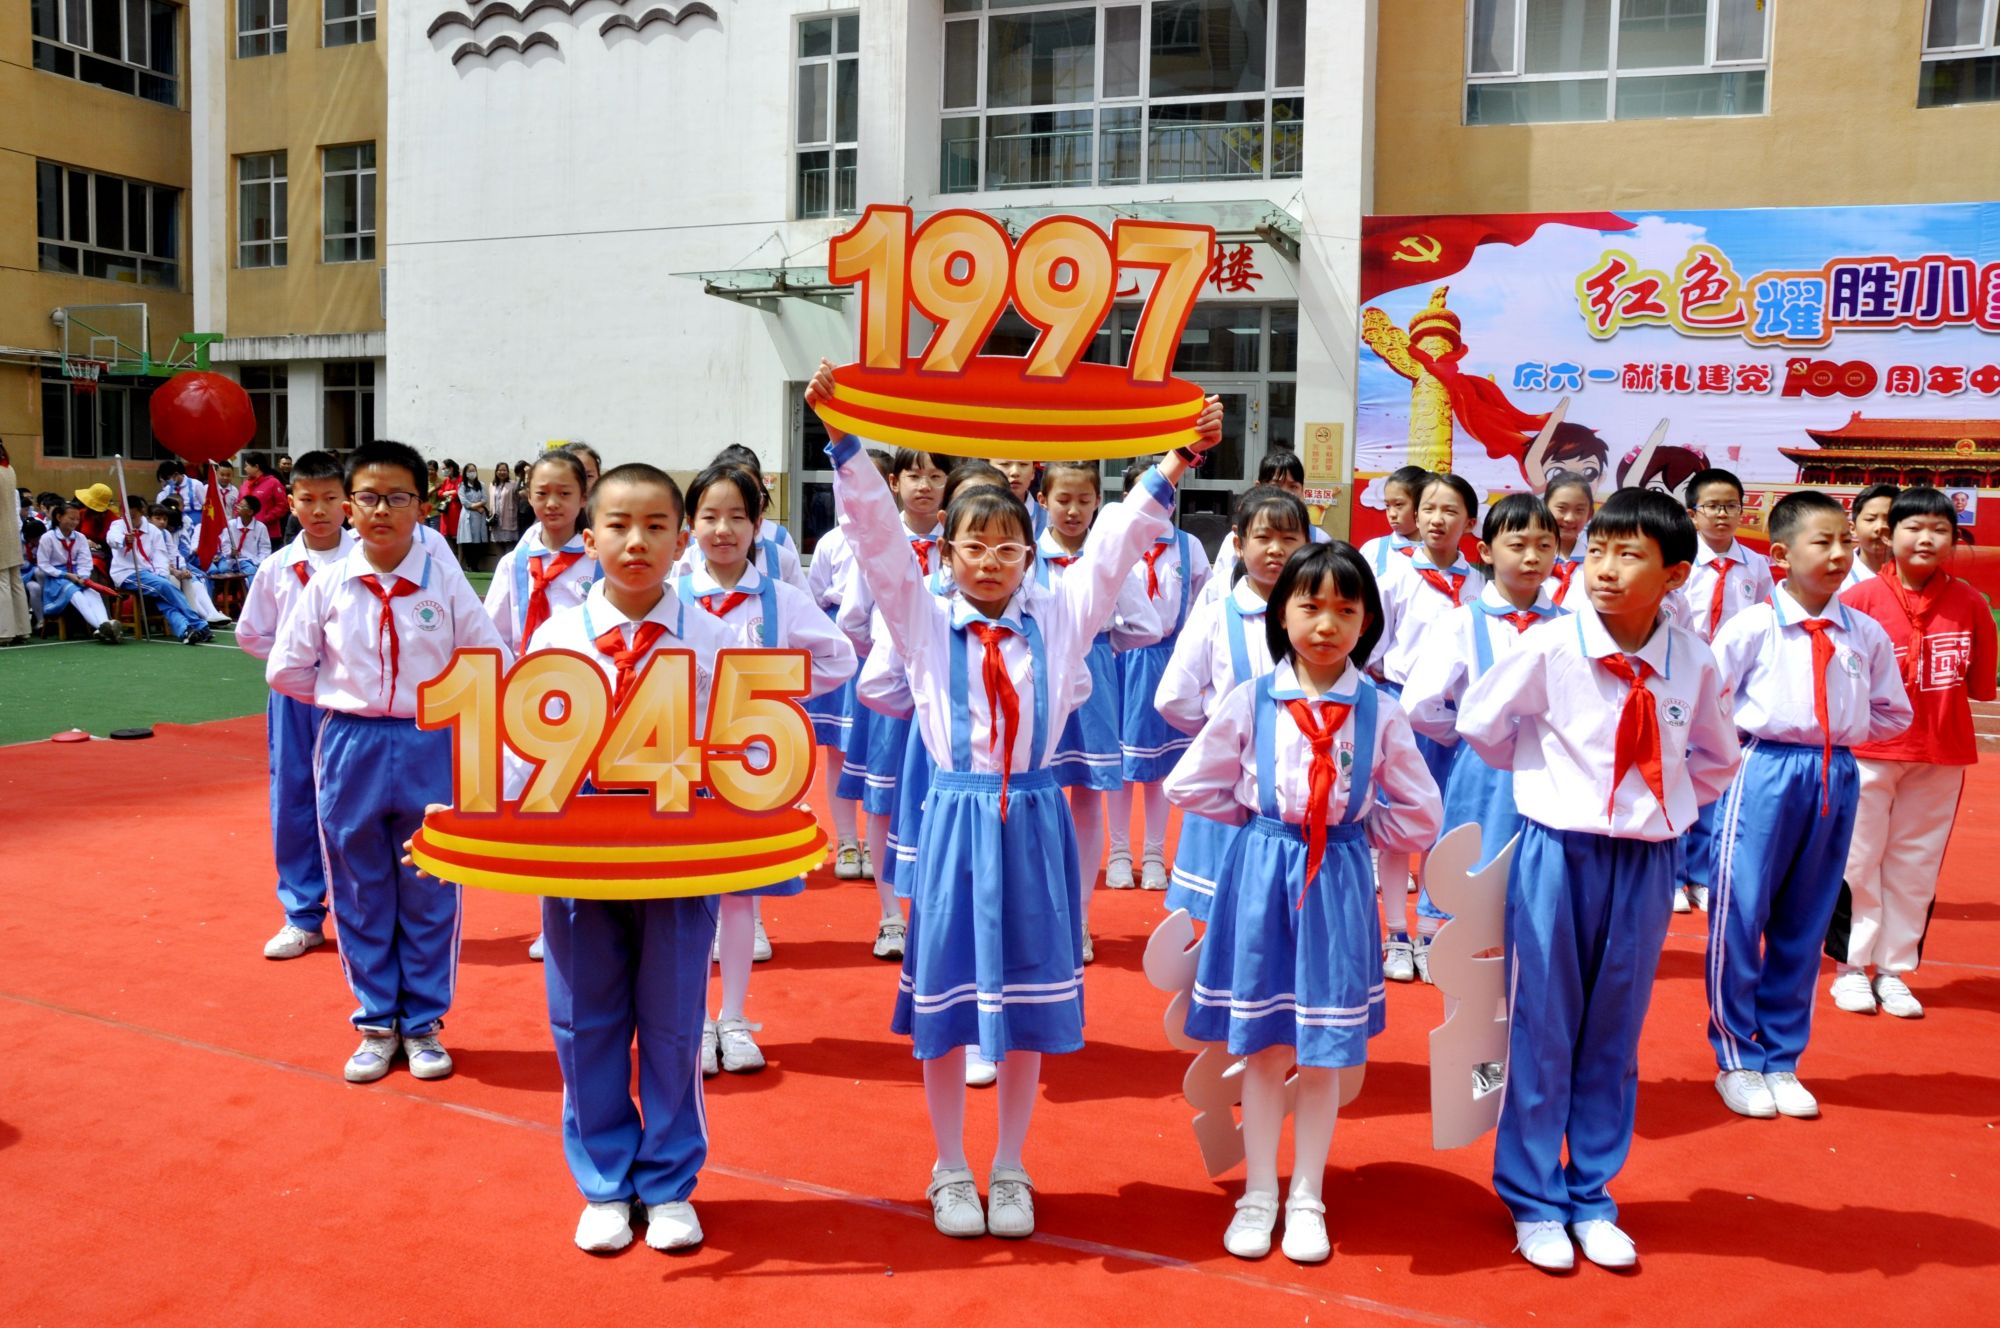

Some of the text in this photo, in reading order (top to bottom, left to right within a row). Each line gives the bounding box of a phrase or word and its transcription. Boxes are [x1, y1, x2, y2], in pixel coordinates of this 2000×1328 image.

[828, 203, 1215, 386] 1997
[1585, 253, 2000, 340] 红色耀胜小
[1304, 488, 1332, 499] 保洁区
[417, 648, 816, 817] 1945
